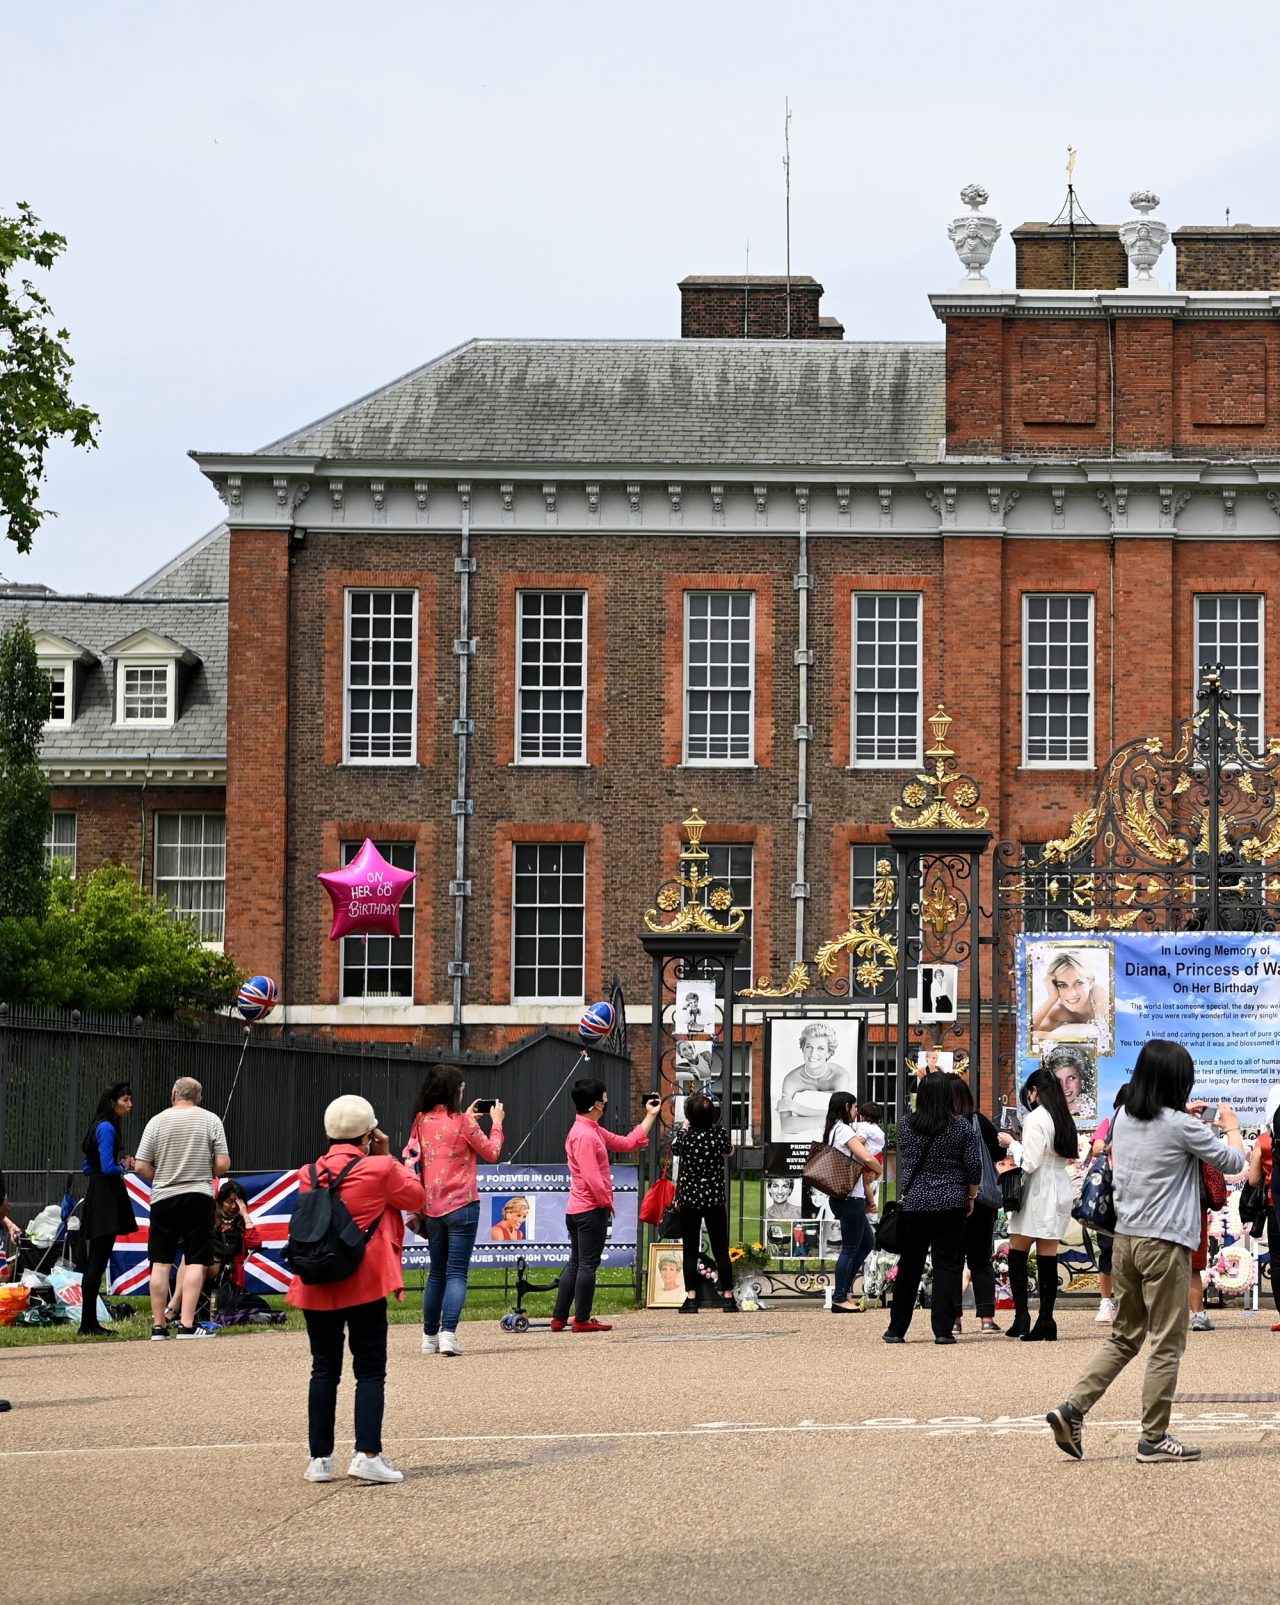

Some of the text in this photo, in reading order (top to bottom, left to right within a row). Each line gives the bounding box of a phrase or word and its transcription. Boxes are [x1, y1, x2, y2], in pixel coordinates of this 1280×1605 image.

[367, 872, 384, 883] ON
[351, 886, 372, 899] HER
[1161, 945, 1270, 958] In Loving Memory of
[1126, 963, 1170, 978] Diana,
[1176, 962, 1240, 976] Princess
[1245, 962, 1259, 976] of
[1173, 983, 1258, 995] On Her Birthday
[1206, 1003, 1231, 1011] special,
[1260, 1012, 1278, 1020] single
[1232, 1096, 1244, 1104] day
[487, 1174, 530, 1182] FOREVER
[532, 1174, 541, 1182] IN
[544, 1174, 563, 1182] OUR
[543, 1254, 569, 1262] YOUR
